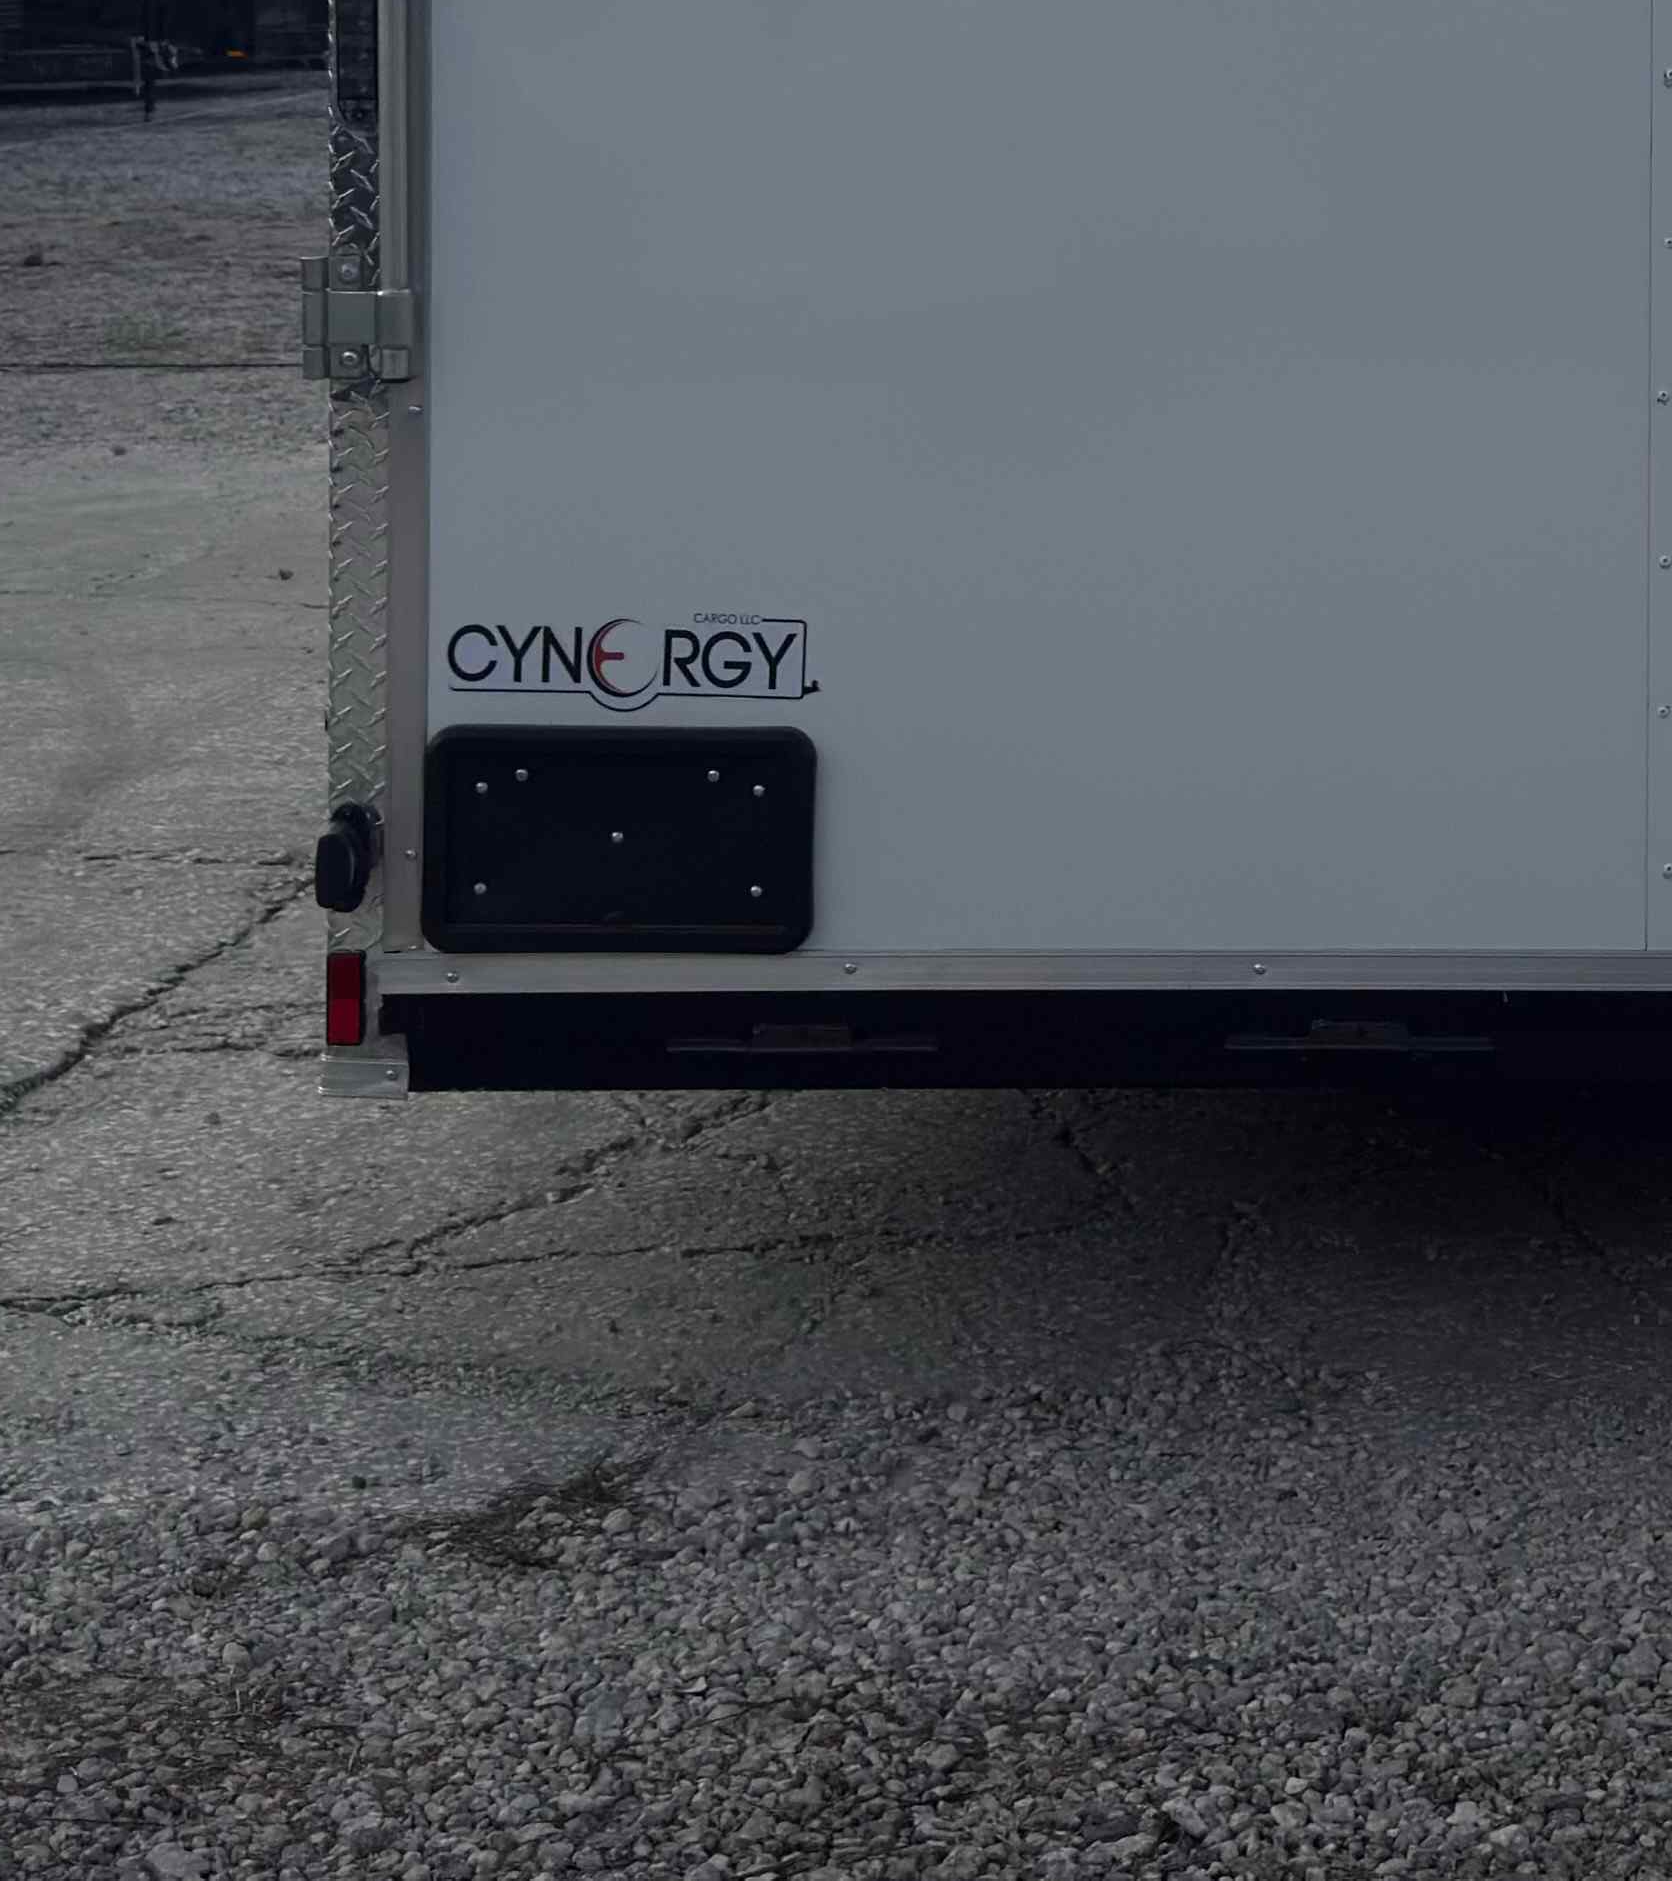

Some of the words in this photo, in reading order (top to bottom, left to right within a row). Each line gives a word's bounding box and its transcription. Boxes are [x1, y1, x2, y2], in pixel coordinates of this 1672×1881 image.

[694, 613, 738, 625] CARGO
[740, 615, 760, 625] LLC
[447, 618, 798, 698] CYNERGY
